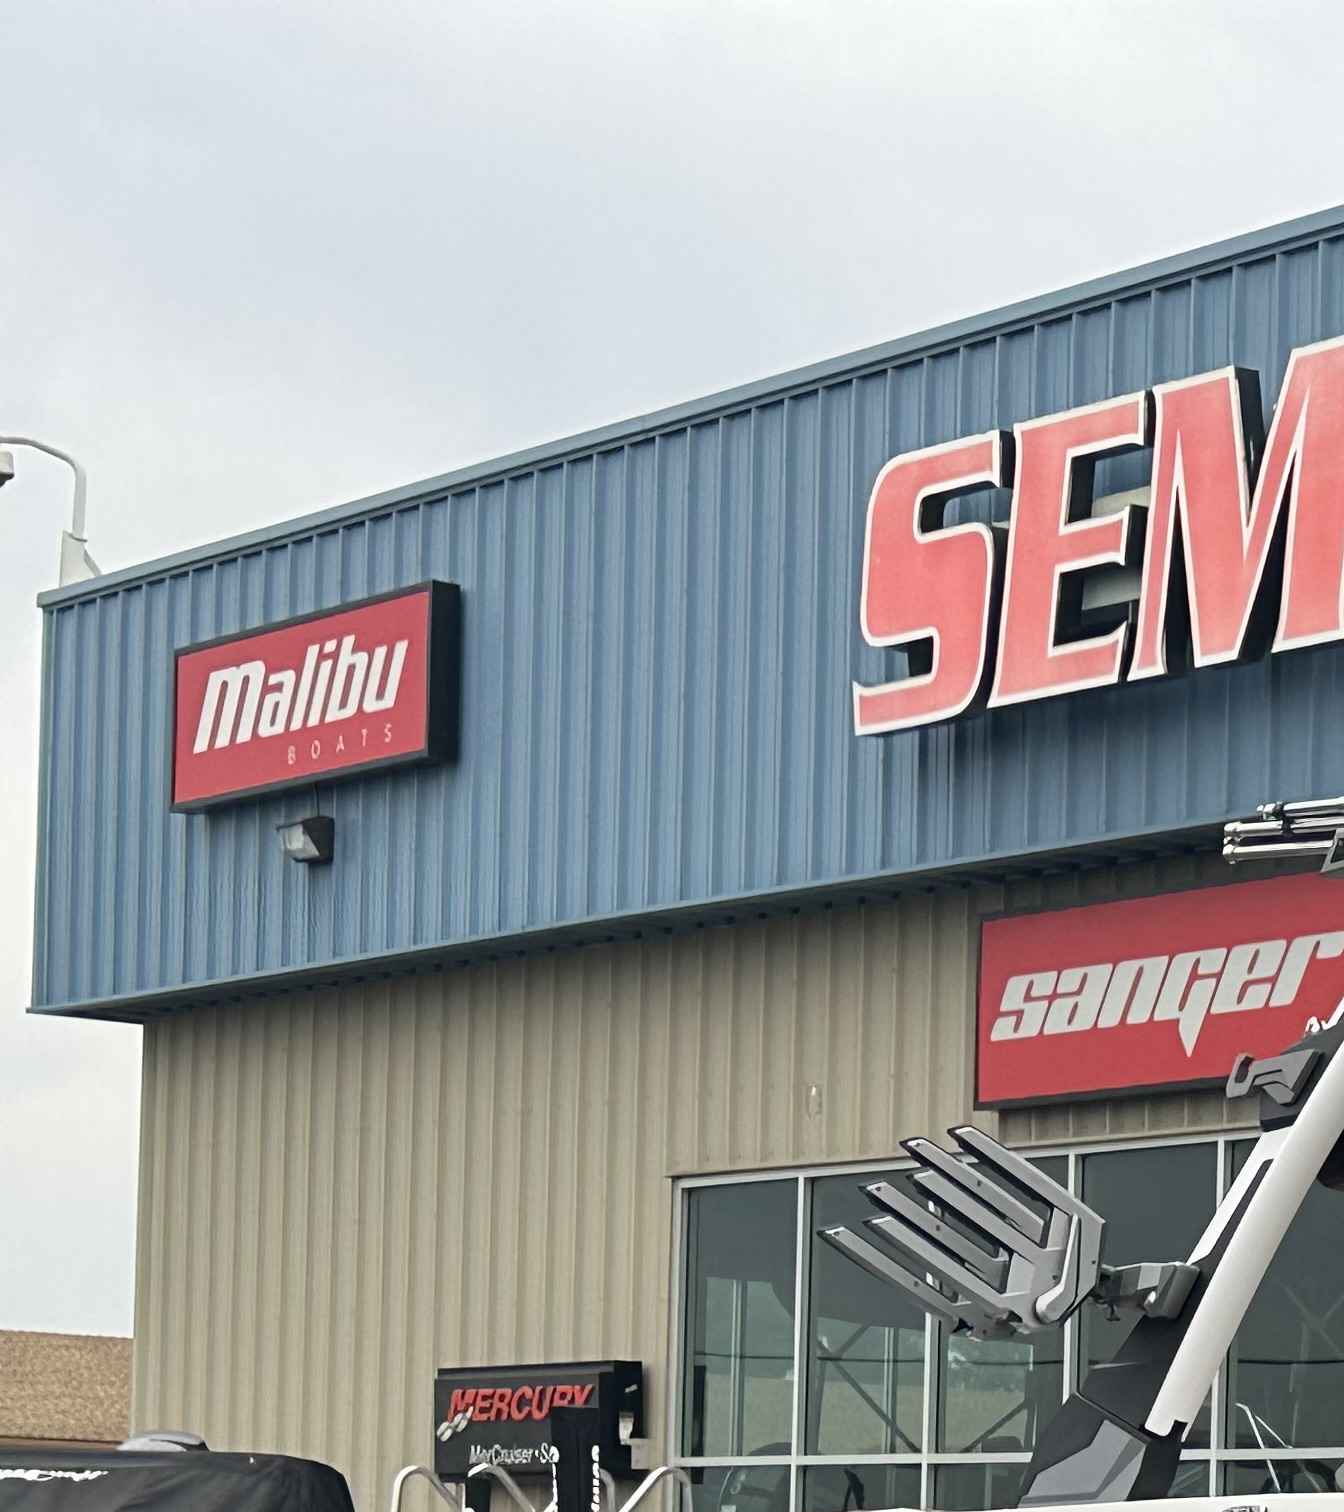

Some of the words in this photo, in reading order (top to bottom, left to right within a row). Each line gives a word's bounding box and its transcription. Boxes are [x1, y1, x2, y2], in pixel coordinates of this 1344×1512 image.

[193, 634, 409, 755] Malibu
[287, 724, 392, 765] BOATS
[448, 1383, 595, 1422] MERCURY
